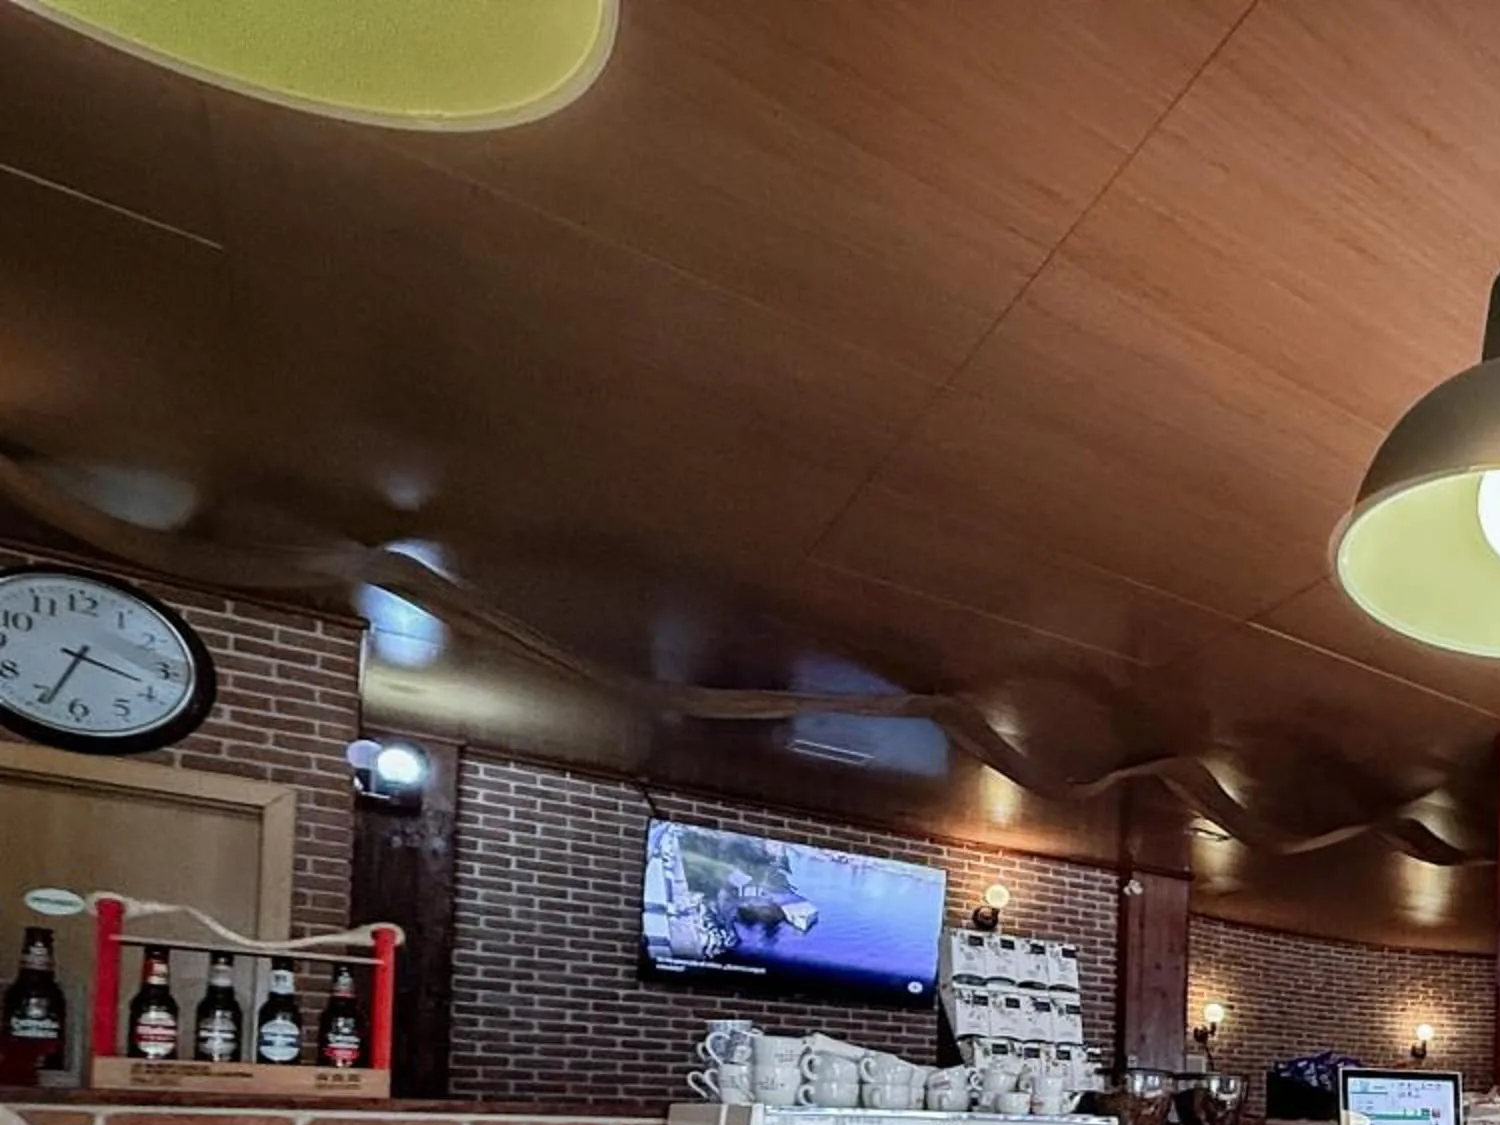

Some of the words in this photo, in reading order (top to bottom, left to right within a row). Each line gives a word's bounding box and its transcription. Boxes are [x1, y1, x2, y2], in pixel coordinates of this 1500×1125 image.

[32, 594, 57, 618] 11
[68, 592, 100, 618] 12
[2, 609, 34, 632] 10
[116, 610, 125, 630] 1
[138, 631, 156, 651] 2
[0, 659, 20, 680] 8
[156, 661, 171, 681] 3
[68, 700, 91, 719] 6
[112, 697, 131, 718] 5
